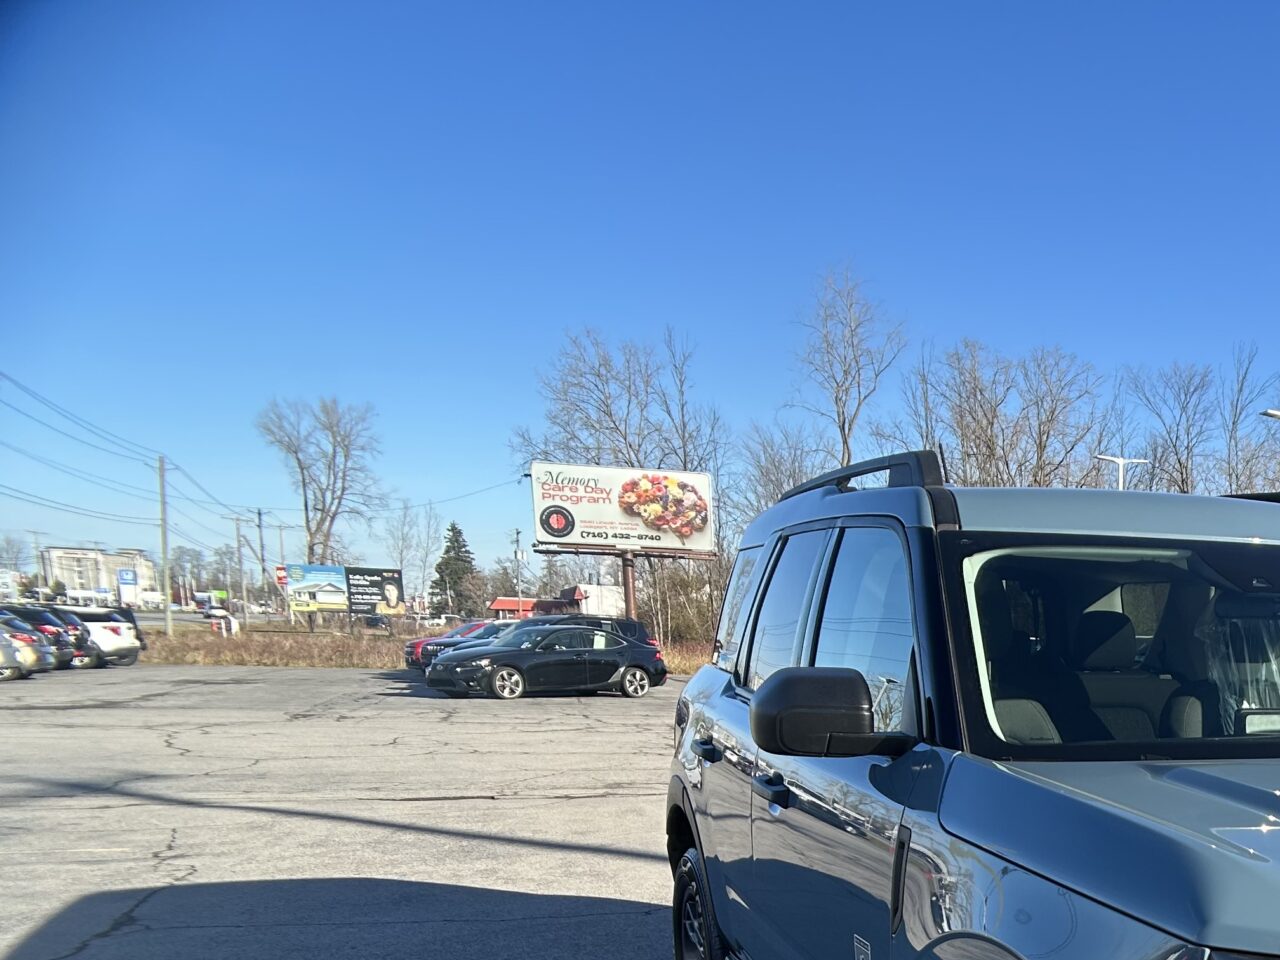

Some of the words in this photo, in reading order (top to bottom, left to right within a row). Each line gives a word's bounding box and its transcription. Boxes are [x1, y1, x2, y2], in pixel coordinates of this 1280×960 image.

[537, 471, 599, 487] Memory
[541, 483, 578, 493] Care
[584, 485, 612, 497] Day
[541, 492, 612, 504] Program
[580, 531, 609, 539] (716)
